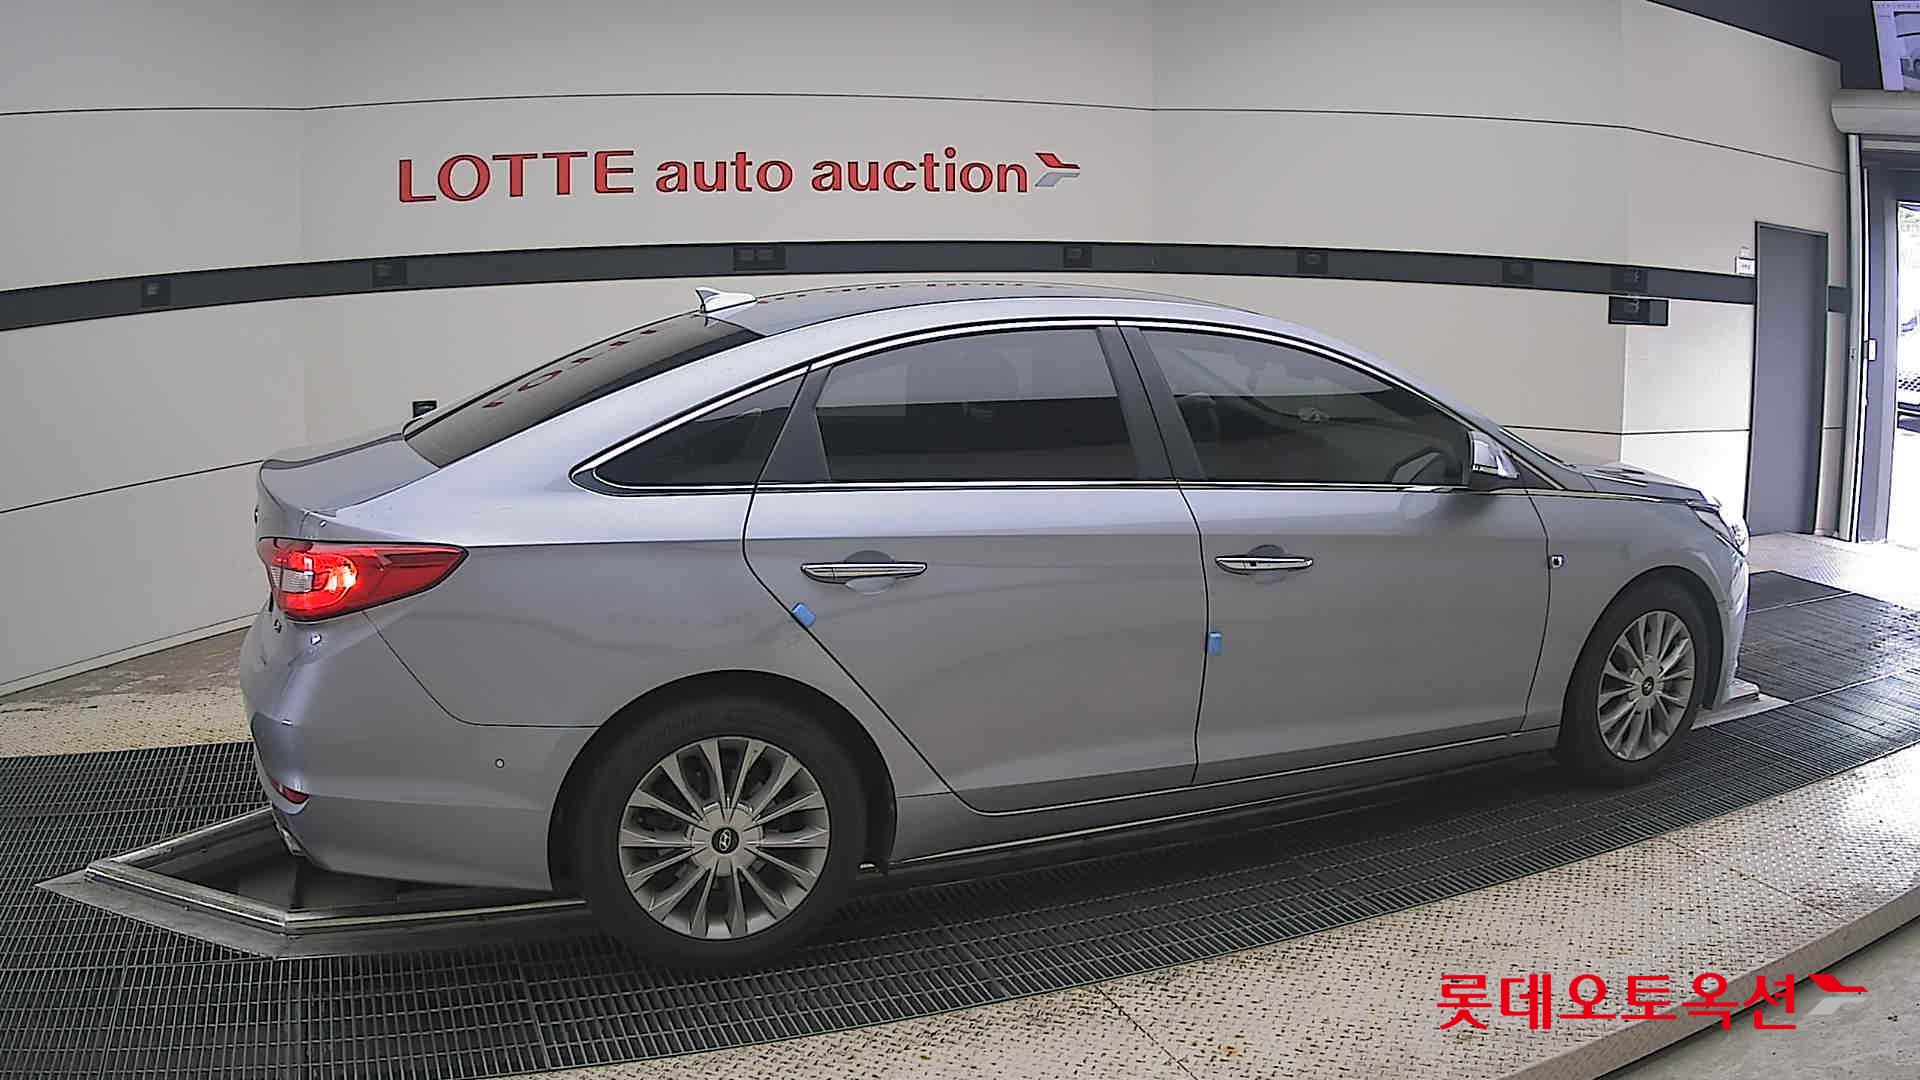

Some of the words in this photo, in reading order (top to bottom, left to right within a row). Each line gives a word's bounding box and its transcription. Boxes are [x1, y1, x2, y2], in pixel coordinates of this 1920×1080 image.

[398, 150, 634, 203] LOTTE
[655, 151, 796, 193] auto
[810, 146, 1030, 194] auction
